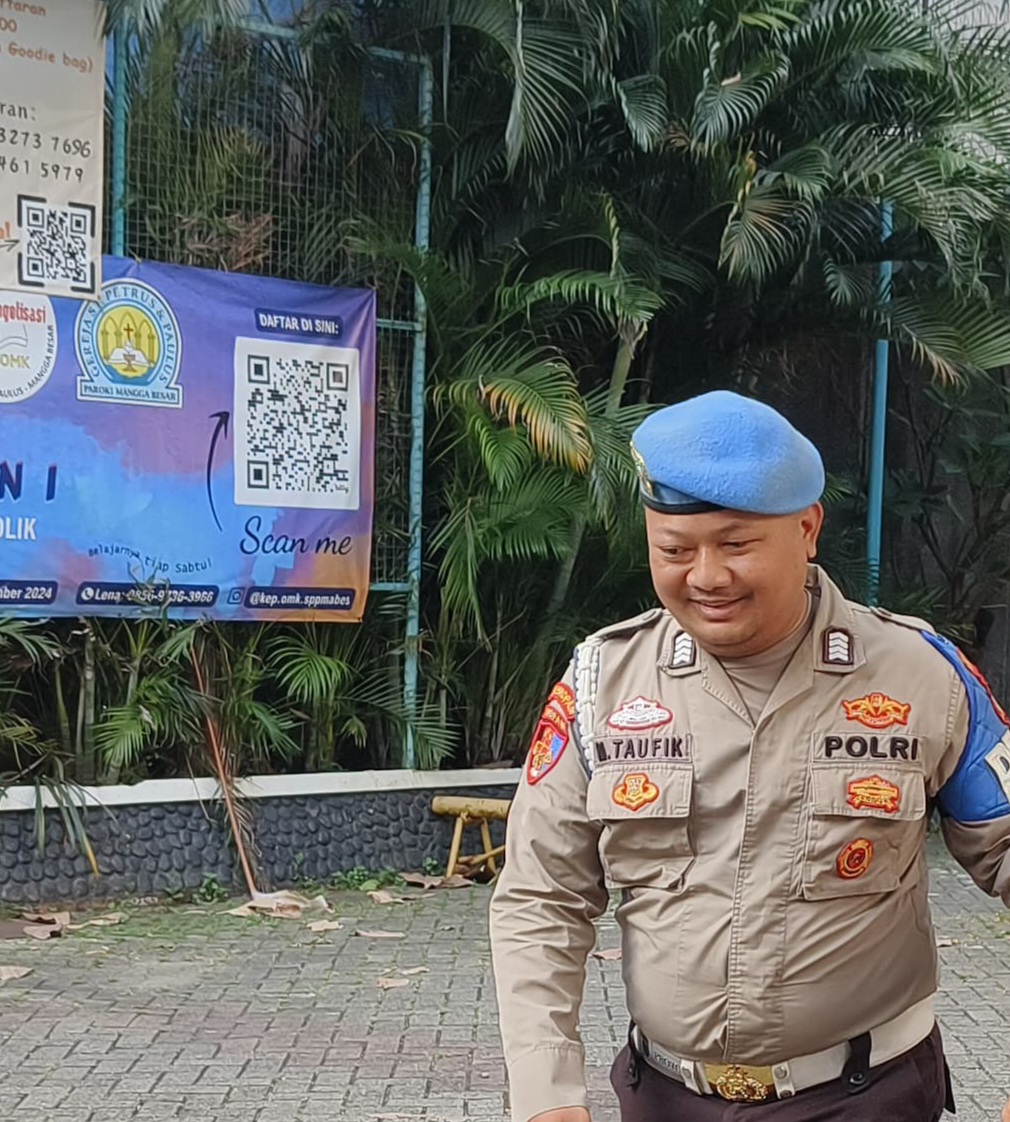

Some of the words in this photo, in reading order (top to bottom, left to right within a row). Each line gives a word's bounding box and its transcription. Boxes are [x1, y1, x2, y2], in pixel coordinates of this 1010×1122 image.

[8, 41, 56, 64] Goodie
[62, 51, 94, 73] bag)
[51, 136, 91, 158] 7696
[41, 162, 84, 182] 5979
[259, 313, 300, 330] DAFTAR
[301, 318, 313, 331] DI
[314, 319, 339, 334] SINI:
[105, 286, 156, 309] PETRUS
[160, 323, 176, 384] PAULUS
[0, 354, 30, 369] OMK
[84, 384, 114, 395] PAROKI
[115, 387, 150, 398] MANGGA
[151, 391, 176, 401] BESAR
[240, 515, 309, 555] Scan
[315, 535, 353, 555] me
[24, 586, 52, 599] 2024
[824, 735, 919, 761] POLRI
